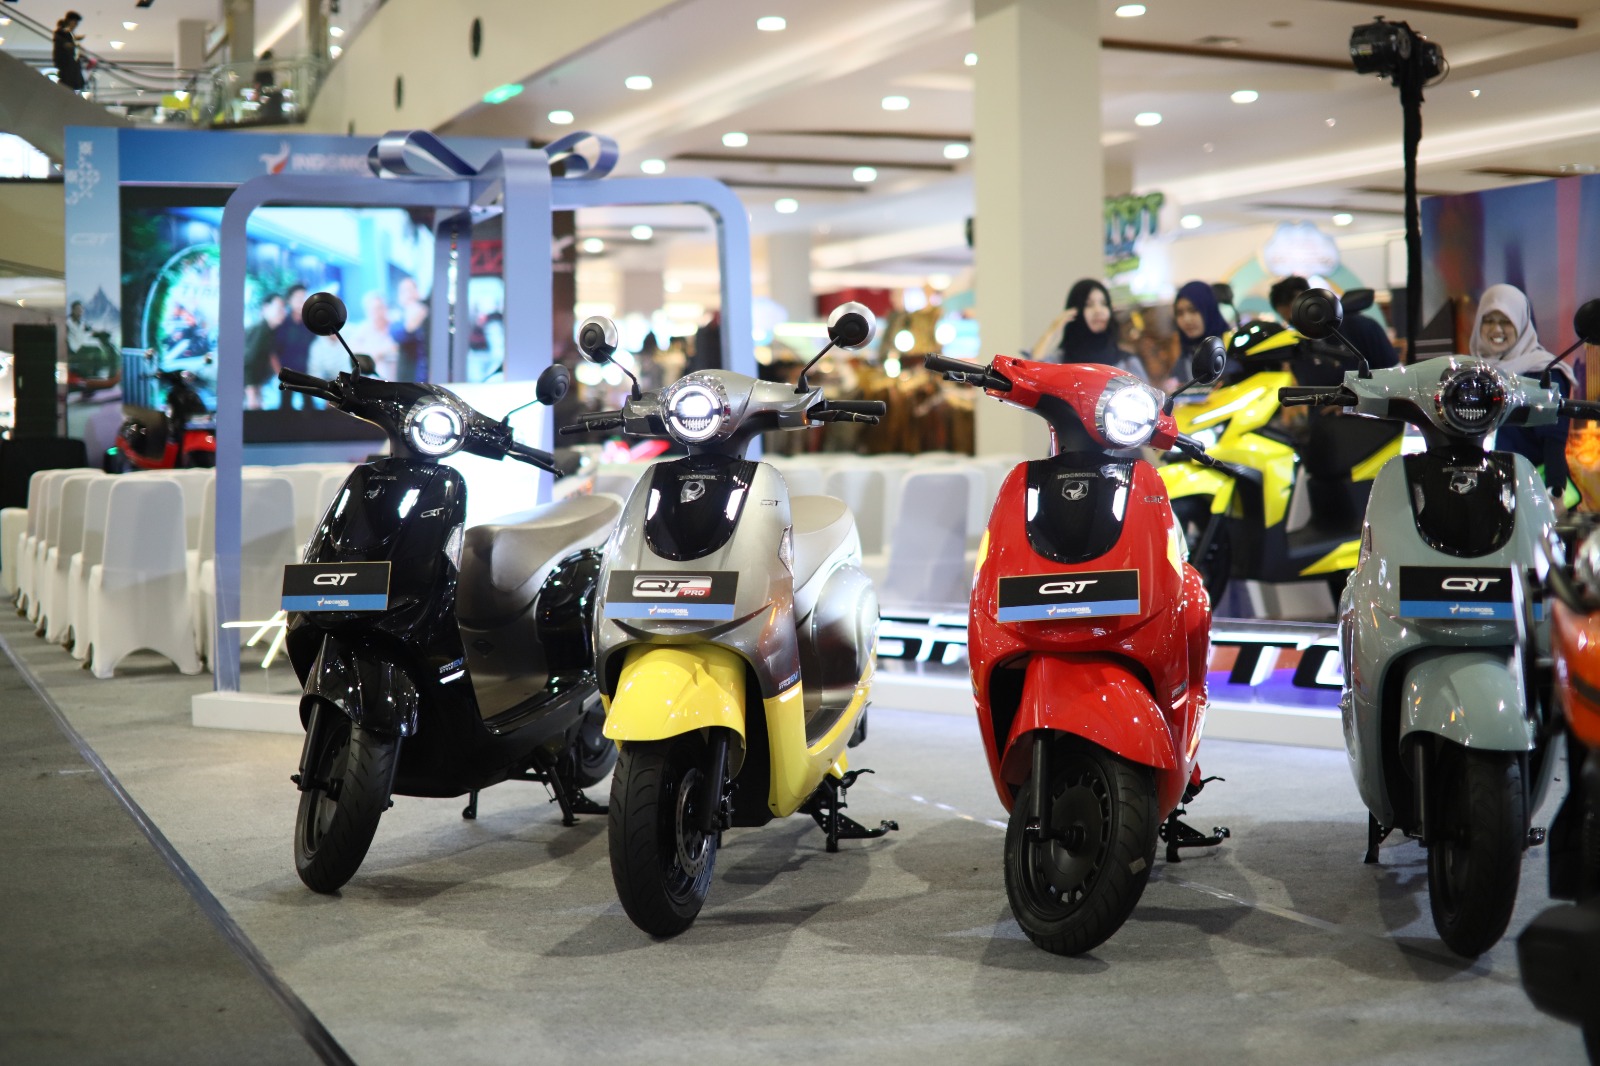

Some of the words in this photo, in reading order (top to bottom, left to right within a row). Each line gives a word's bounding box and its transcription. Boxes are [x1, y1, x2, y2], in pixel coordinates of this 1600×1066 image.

[420, 507, 445, 519] QT
[313, 572, 358, 586] QT
[635, 579, 691, 593] QT
[1441, 577, 1502, 592] QT
[1038, 579, 1099, 595] QT
